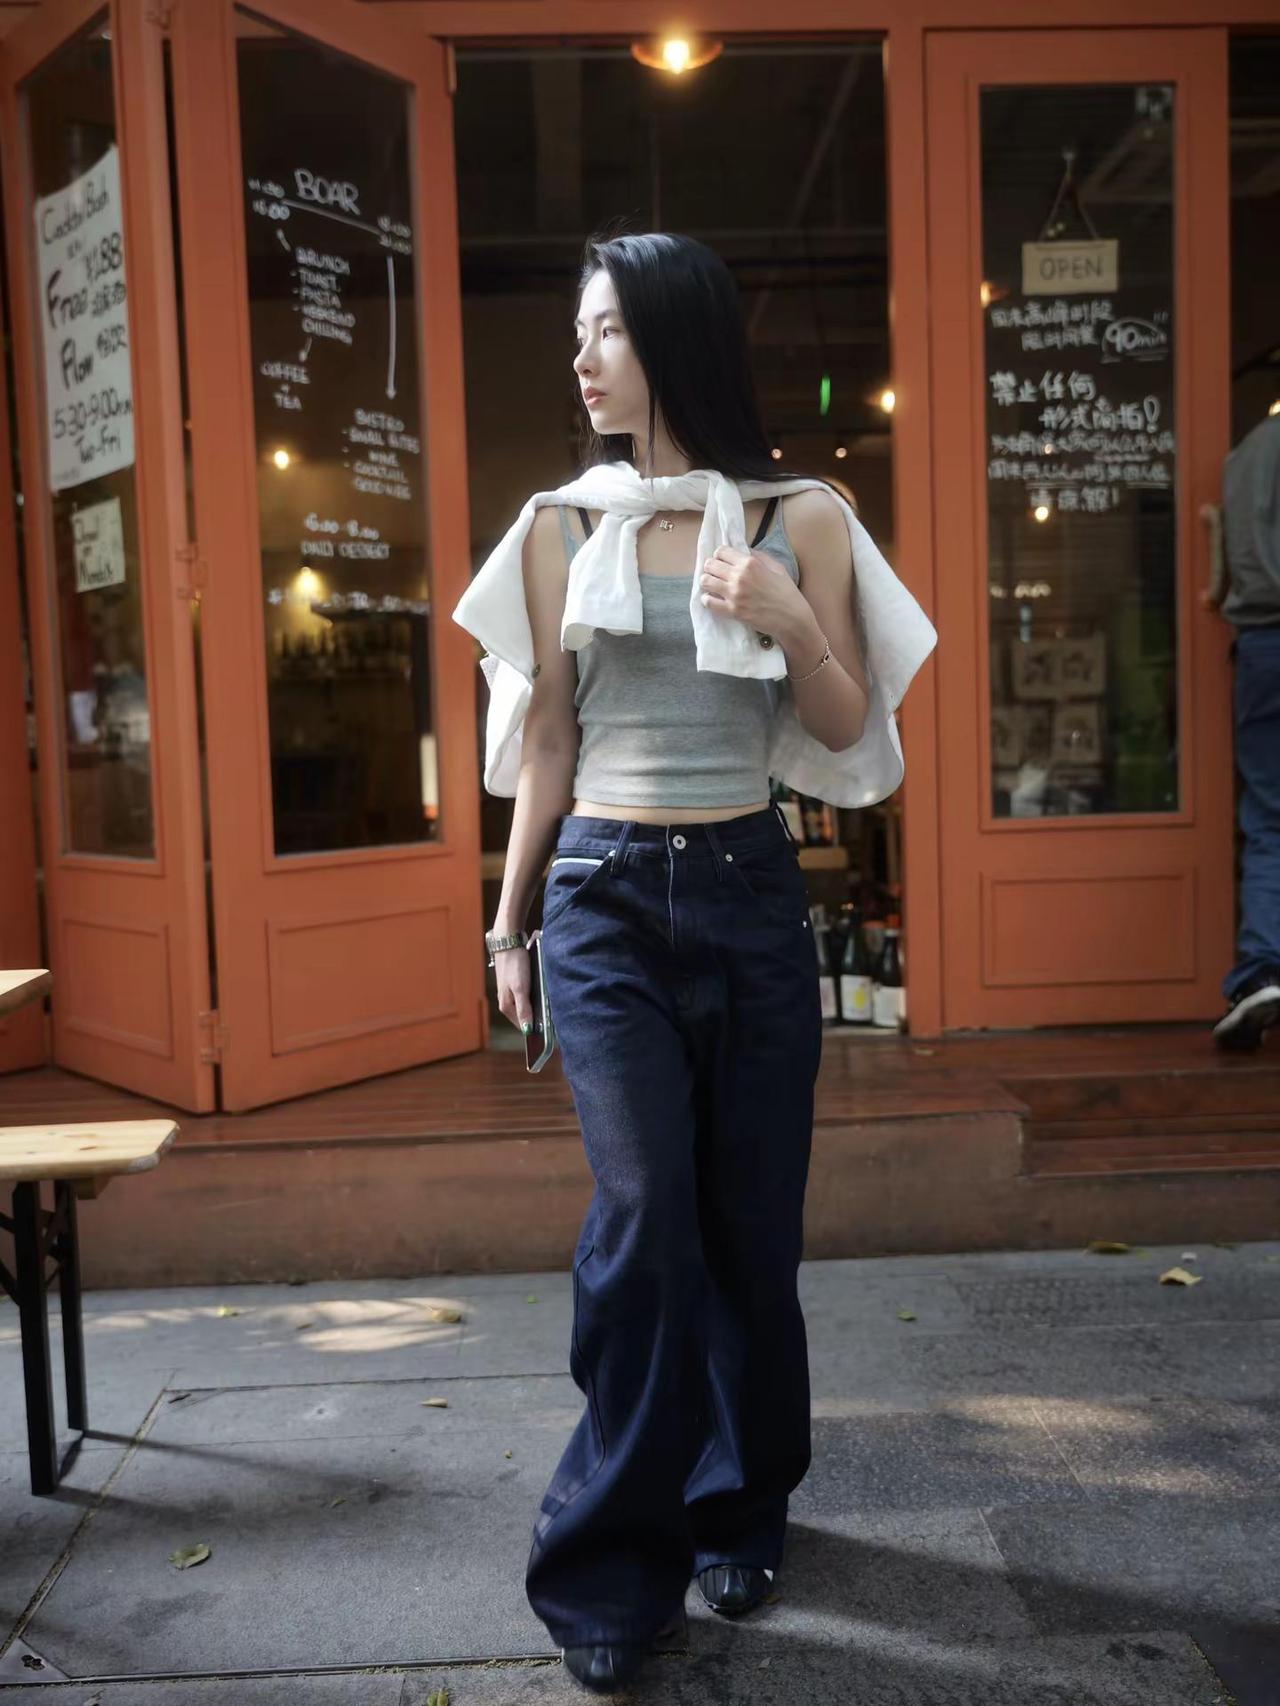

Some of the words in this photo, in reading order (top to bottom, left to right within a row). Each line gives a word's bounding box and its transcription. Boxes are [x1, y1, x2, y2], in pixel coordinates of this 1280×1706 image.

[294, 168, 361, 215] BOAR
[1039, 257, 1105, 281] OPEN
[989, 369, 1097, 406] 禁止任何
